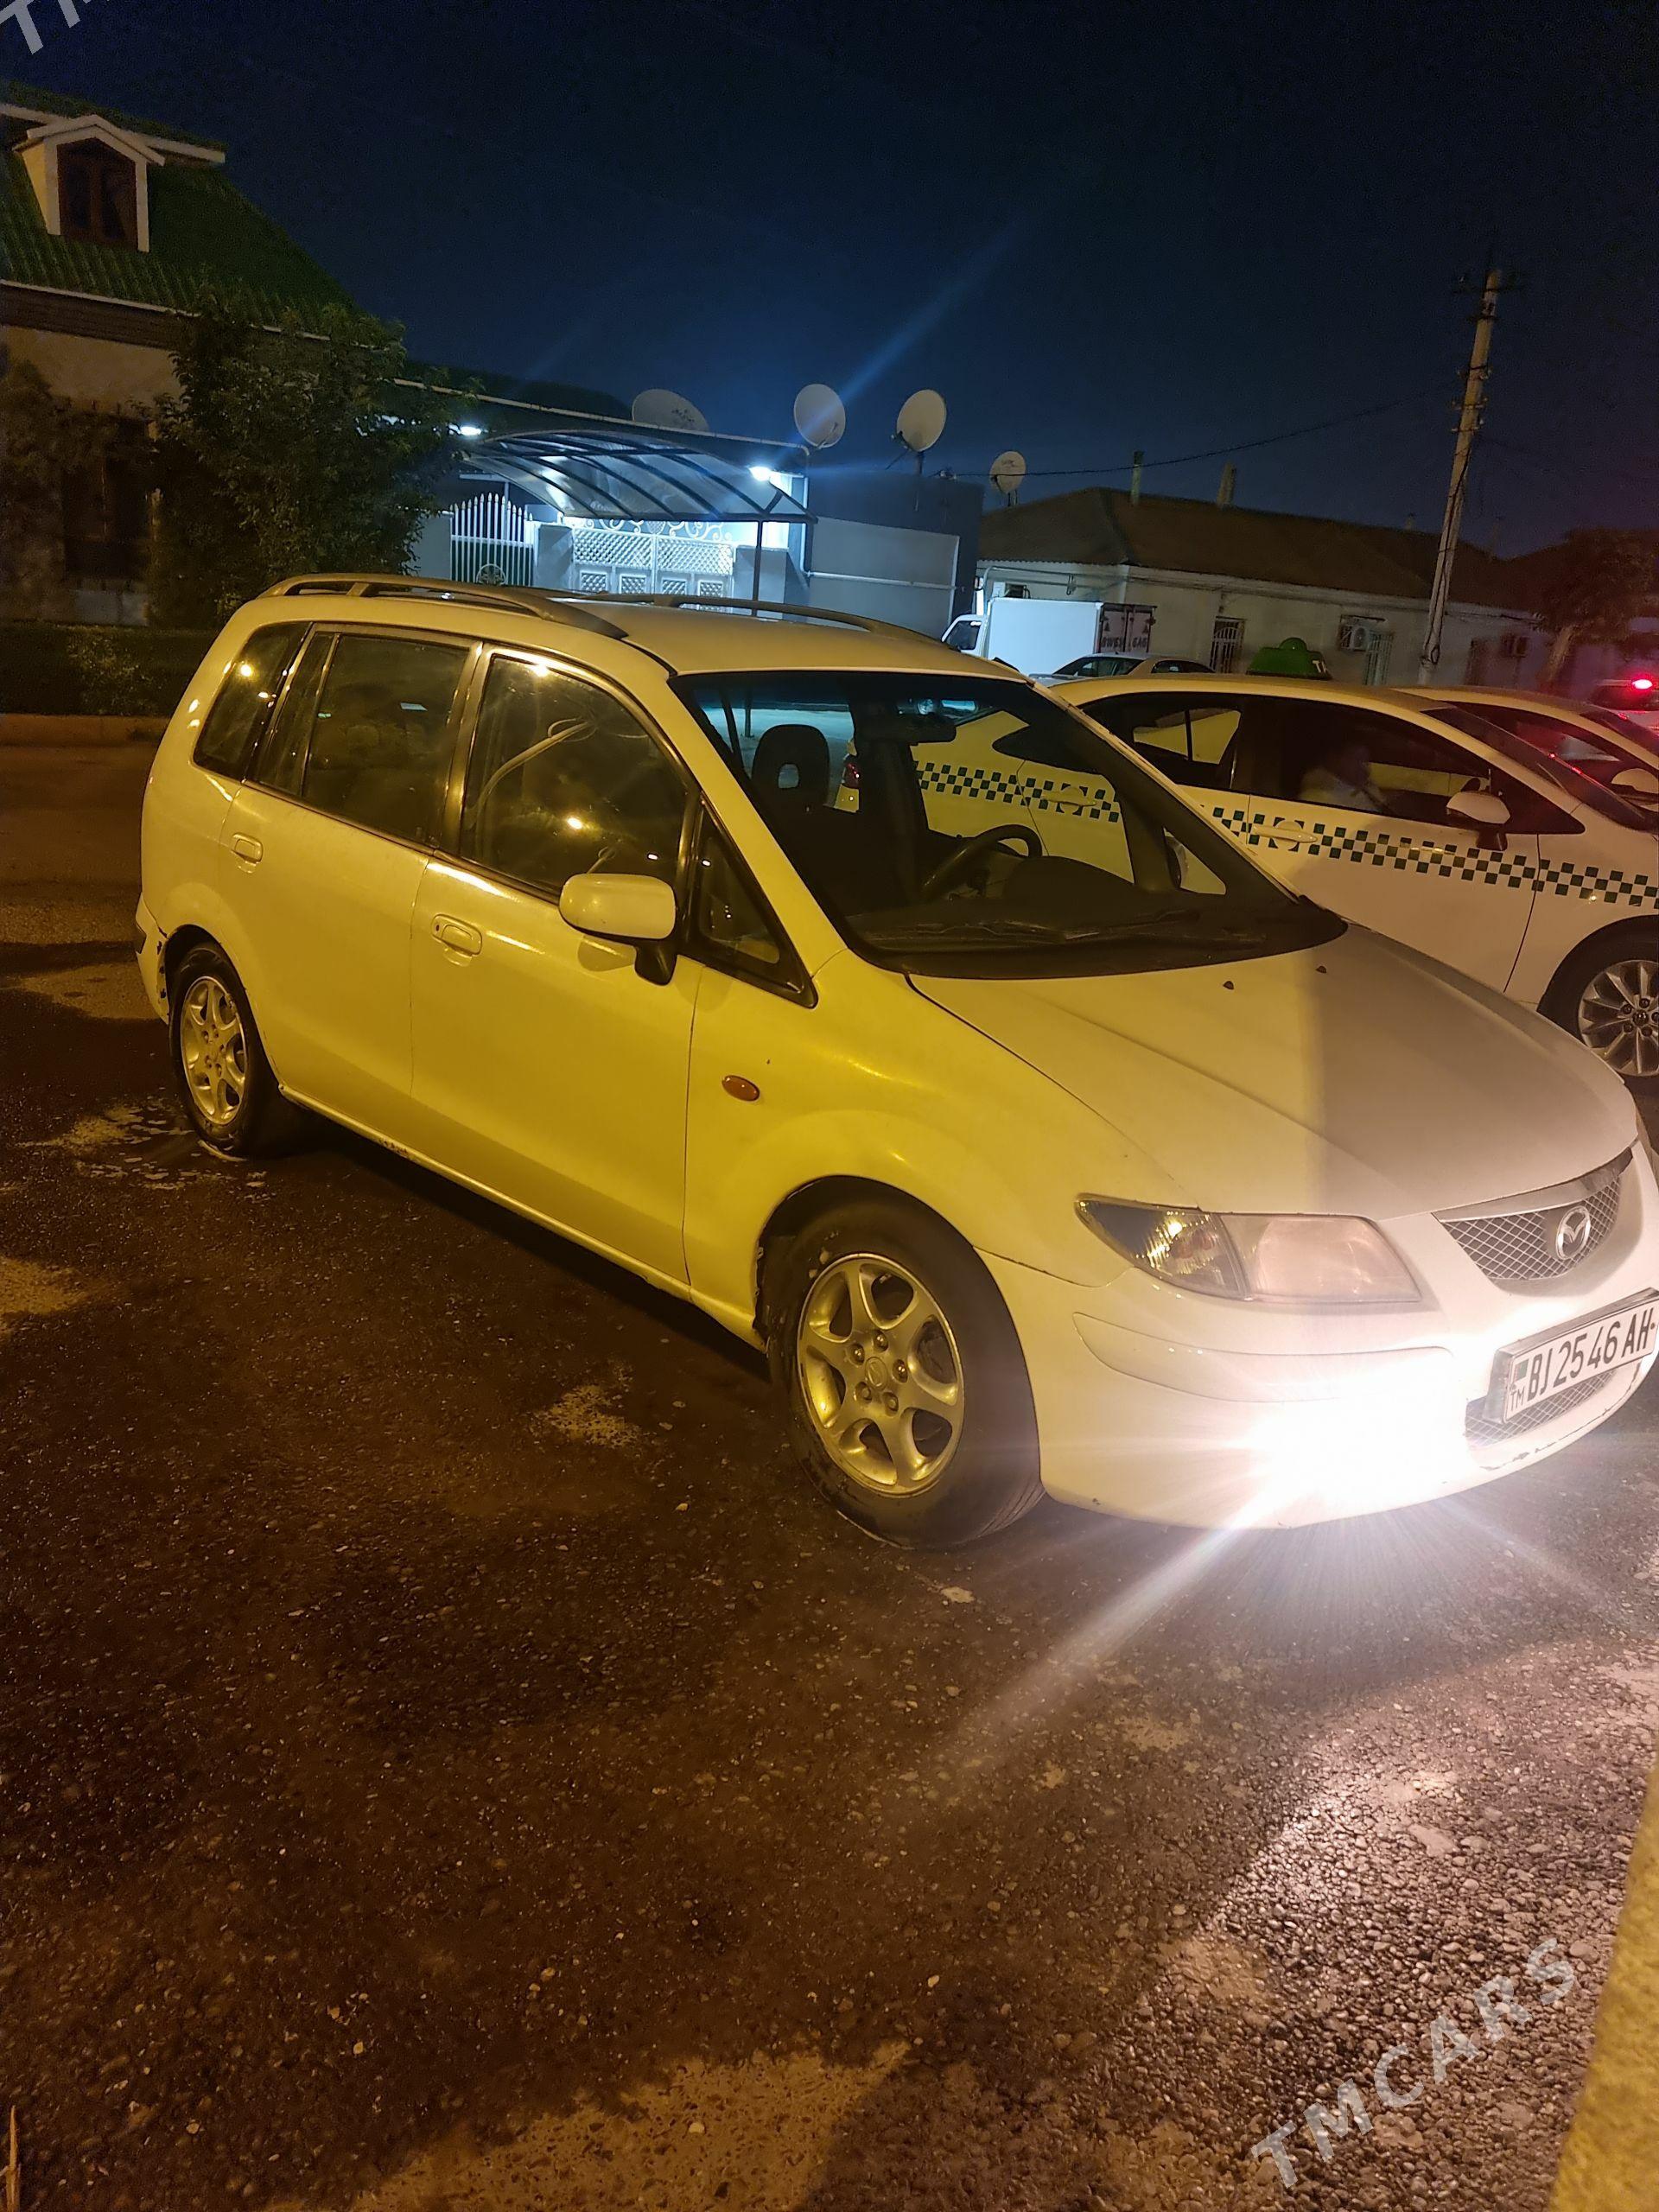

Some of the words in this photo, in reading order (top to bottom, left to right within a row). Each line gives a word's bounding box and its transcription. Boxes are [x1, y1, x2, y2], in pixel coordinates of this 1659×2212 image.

[1527, 1347, 1553, 1402] BJ
[1554, 1320, 1621, 1388] 2546
[1621, 1306, 1654, 1358] AH
[1510, 1388, 1525, 1412] TM
